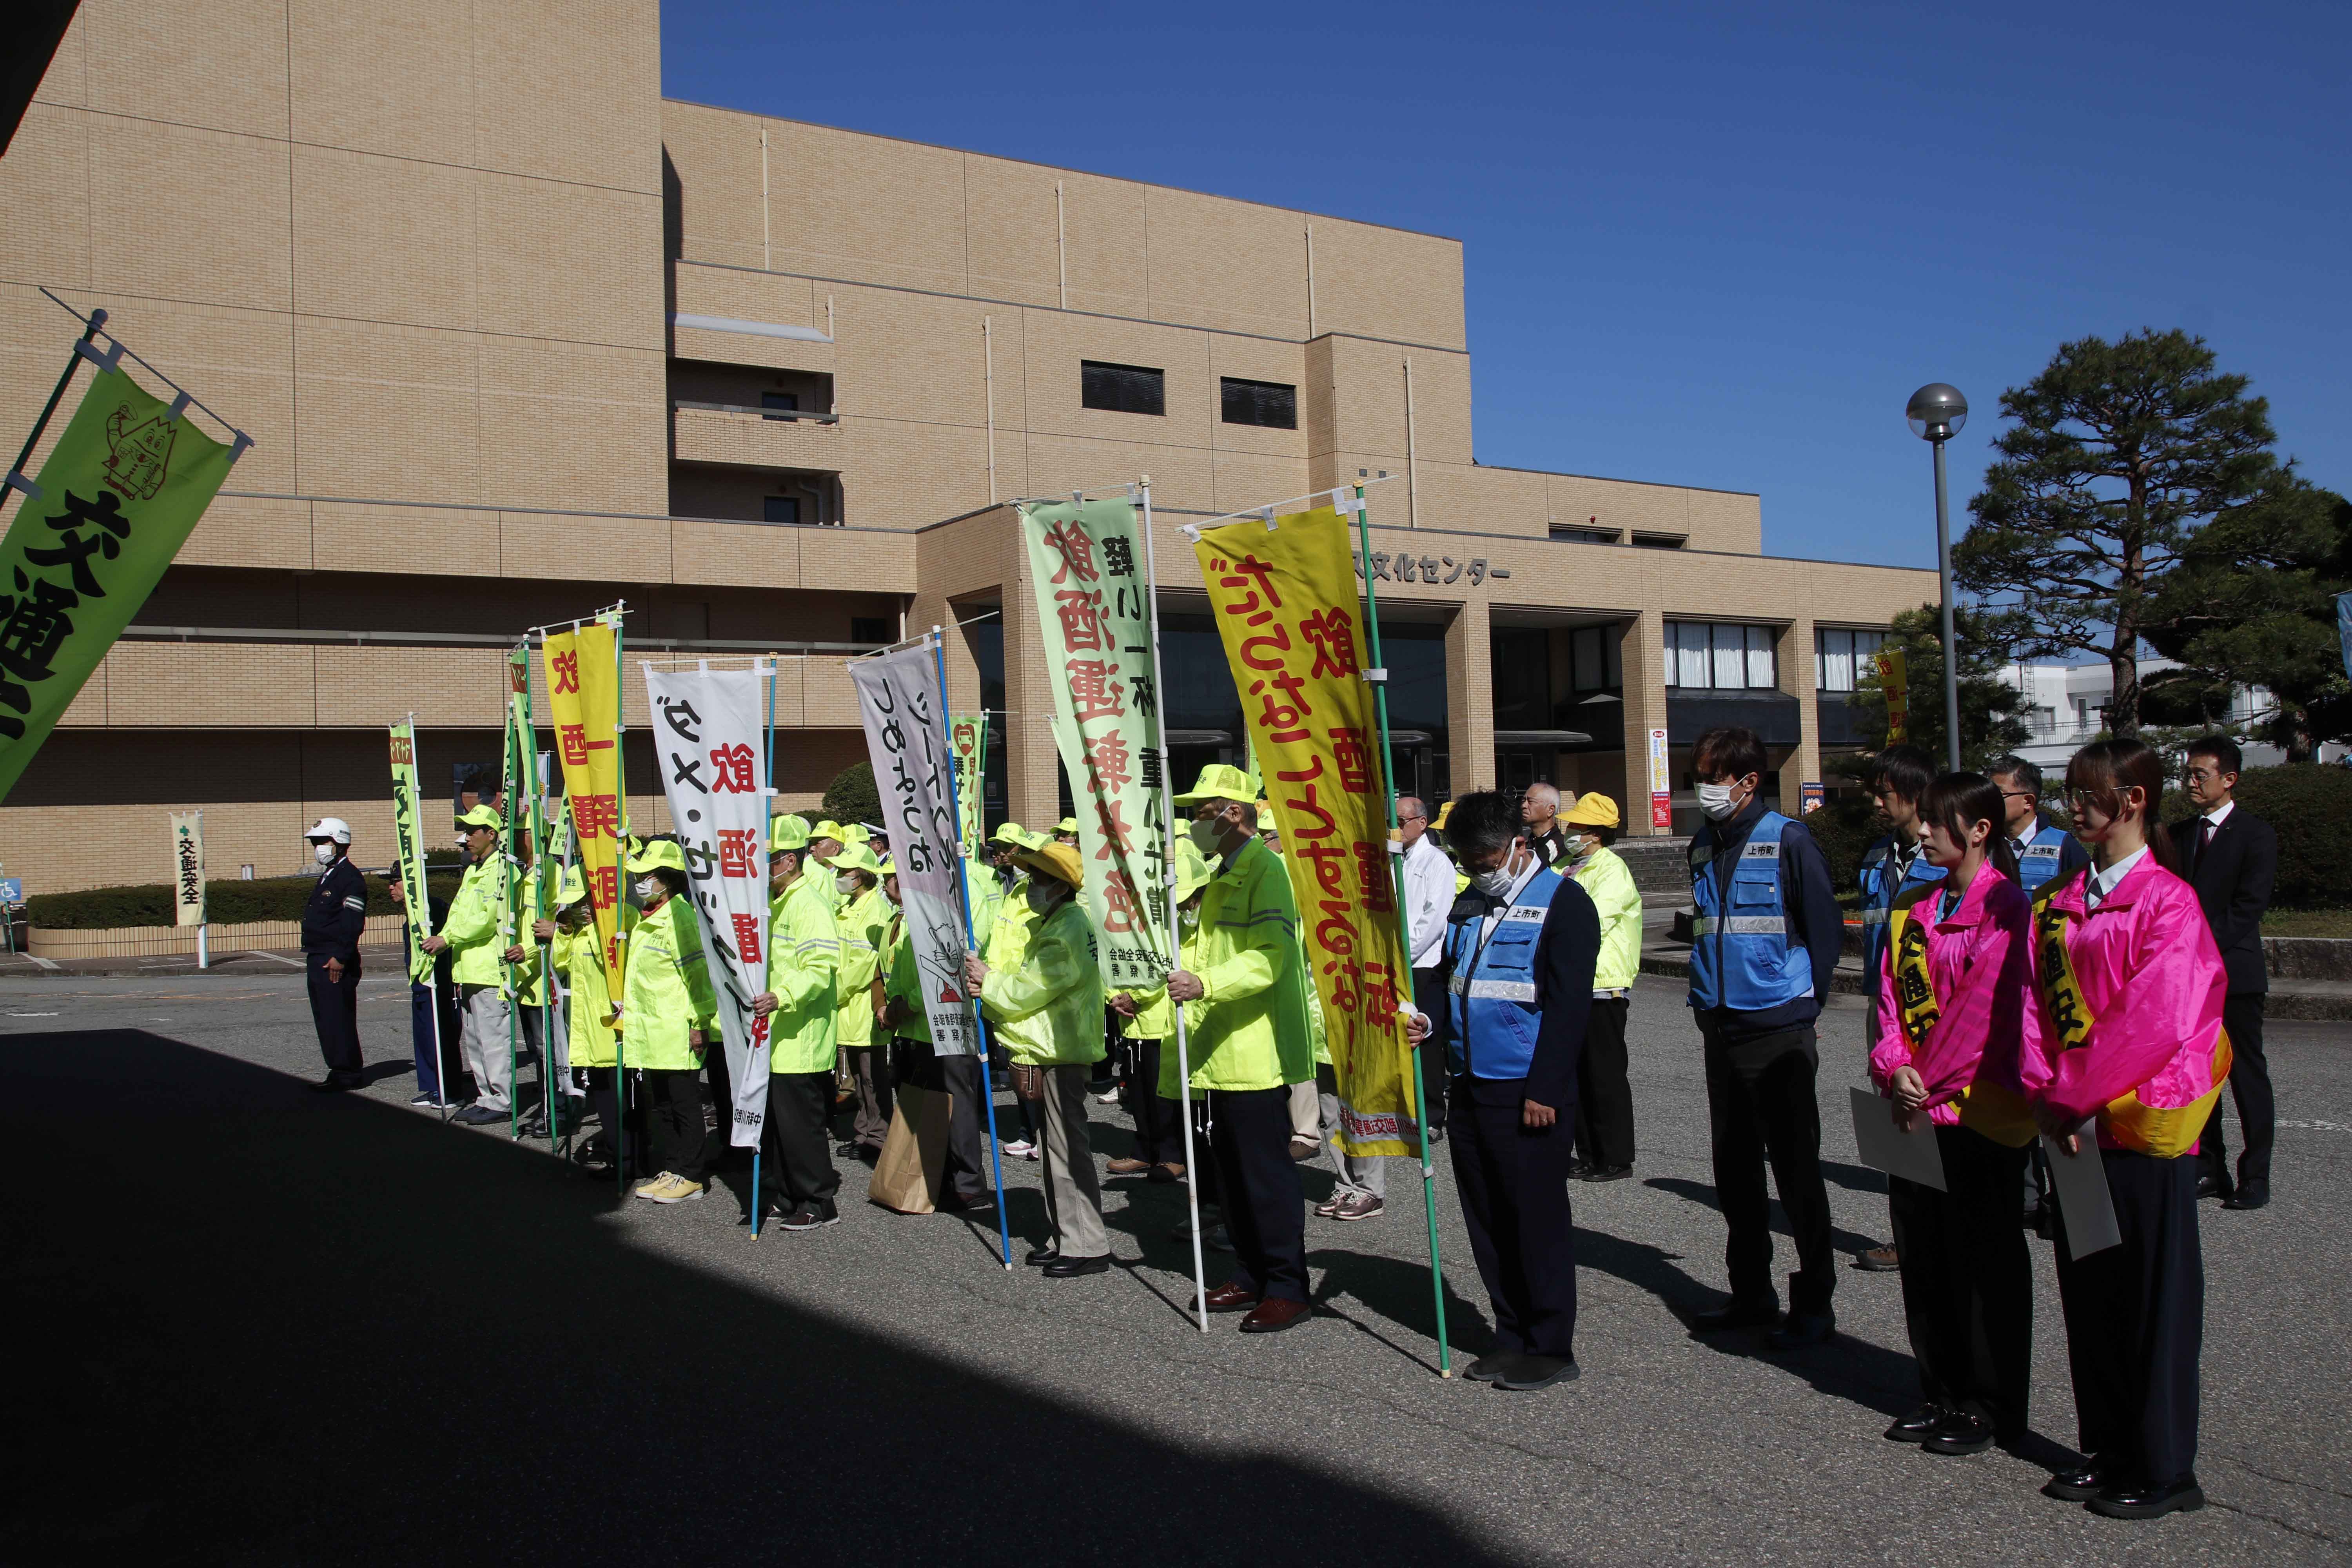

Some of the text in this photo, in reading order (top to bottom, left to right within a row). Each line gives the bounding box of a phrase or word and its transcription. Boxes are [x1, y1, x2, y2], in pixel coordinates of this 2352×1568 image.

[0, 490, 131, 741] 交通
[1748, 846, 1775, 855] 上市町
[2031, 847, 2054, 856] 上市町
[179, 838, 200, 905] 交通安全
[1512, 908, 1541, 919] 上市町
[2038, 899, 2087, 1049] 交通安
